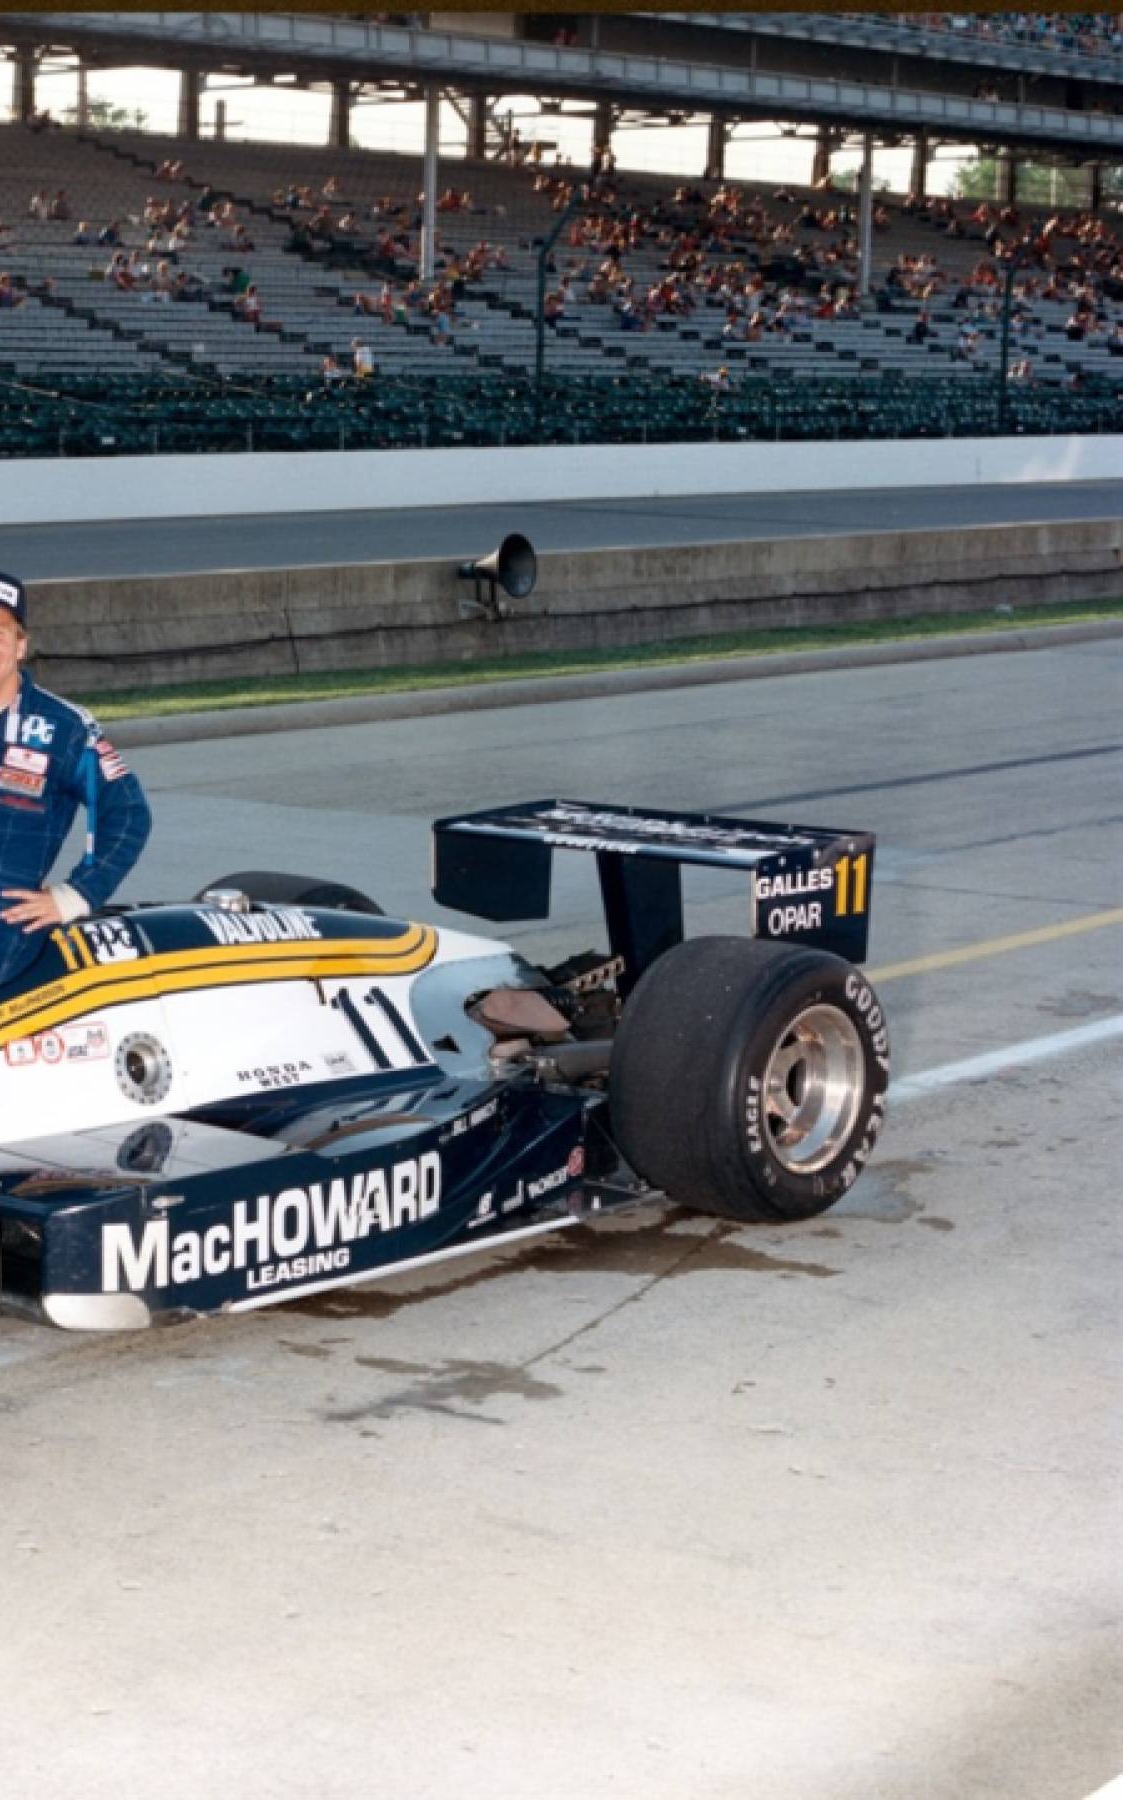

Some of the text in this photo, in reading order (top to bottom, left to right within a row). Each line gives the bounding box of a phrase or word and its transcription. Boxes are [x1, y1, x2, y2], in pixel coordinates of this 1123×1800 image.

[756, 867, 833, 899] GALLES
[834, 853, 867, 917] 11
[332, 985, 430, 1069] 11
[236, 1060, 313, 1082] HONDA
[101, 1150, 442, 1292] MacHOWARD
[246, 1247, 351, 1290] LEASING
